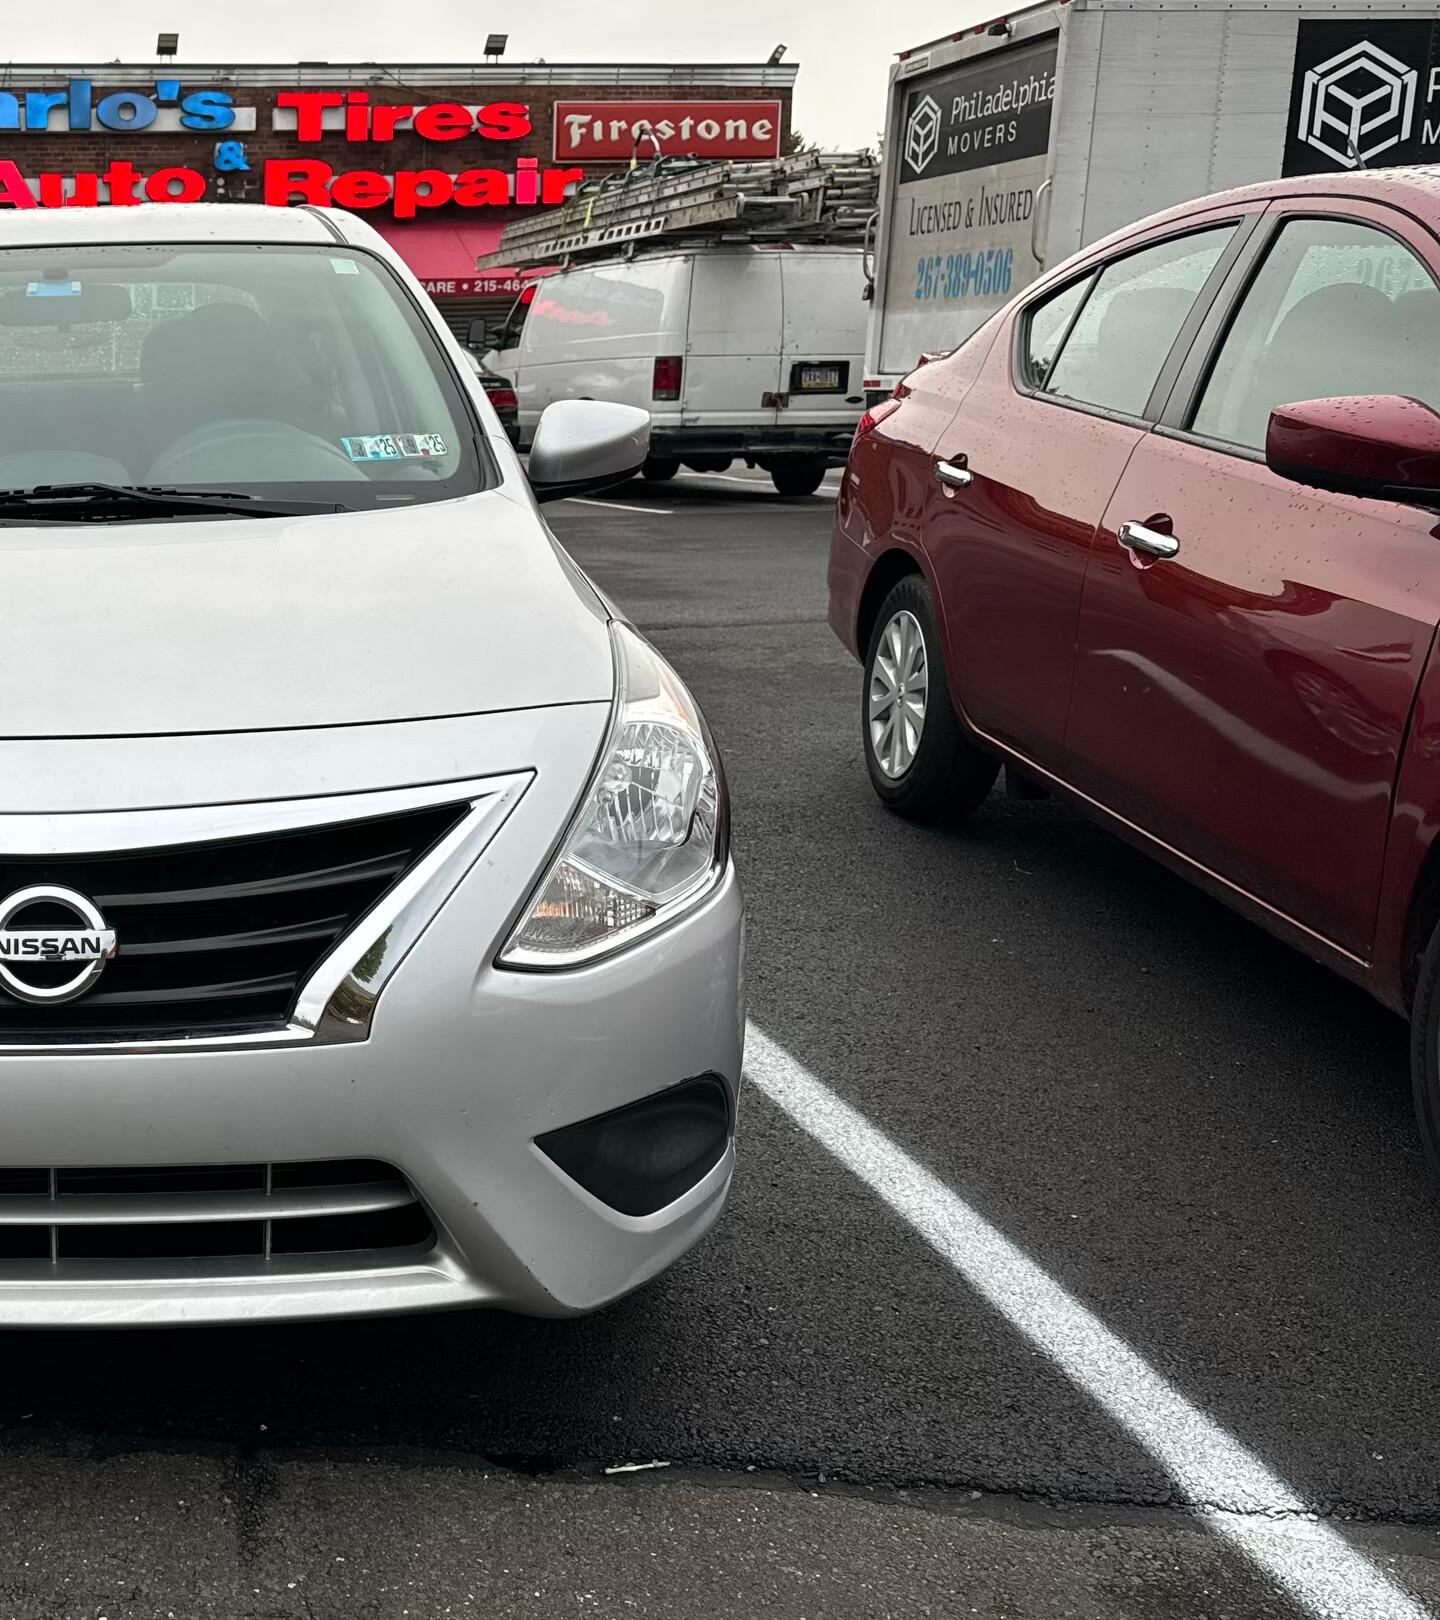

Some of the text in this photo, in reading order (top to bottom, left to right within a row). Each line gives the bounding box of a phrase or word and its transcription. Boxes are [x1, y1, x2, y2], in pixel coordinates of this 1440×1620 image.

[950, 71, 1056, 125] Philadelphia
[276, 92, 532, 142] Tires
[564, 114, 773, 149] Firestone
[214, 140, 251, 171] &
[947, 120, 1017, 156] MOVERS
[264, 157, 583, 217] Repair
[965, 198, 976, 229] &
[914, 248, 1013, 299] 267-389-0506
[380, 438, 397, 455] 25
[428, 435, 446, 453] 25
